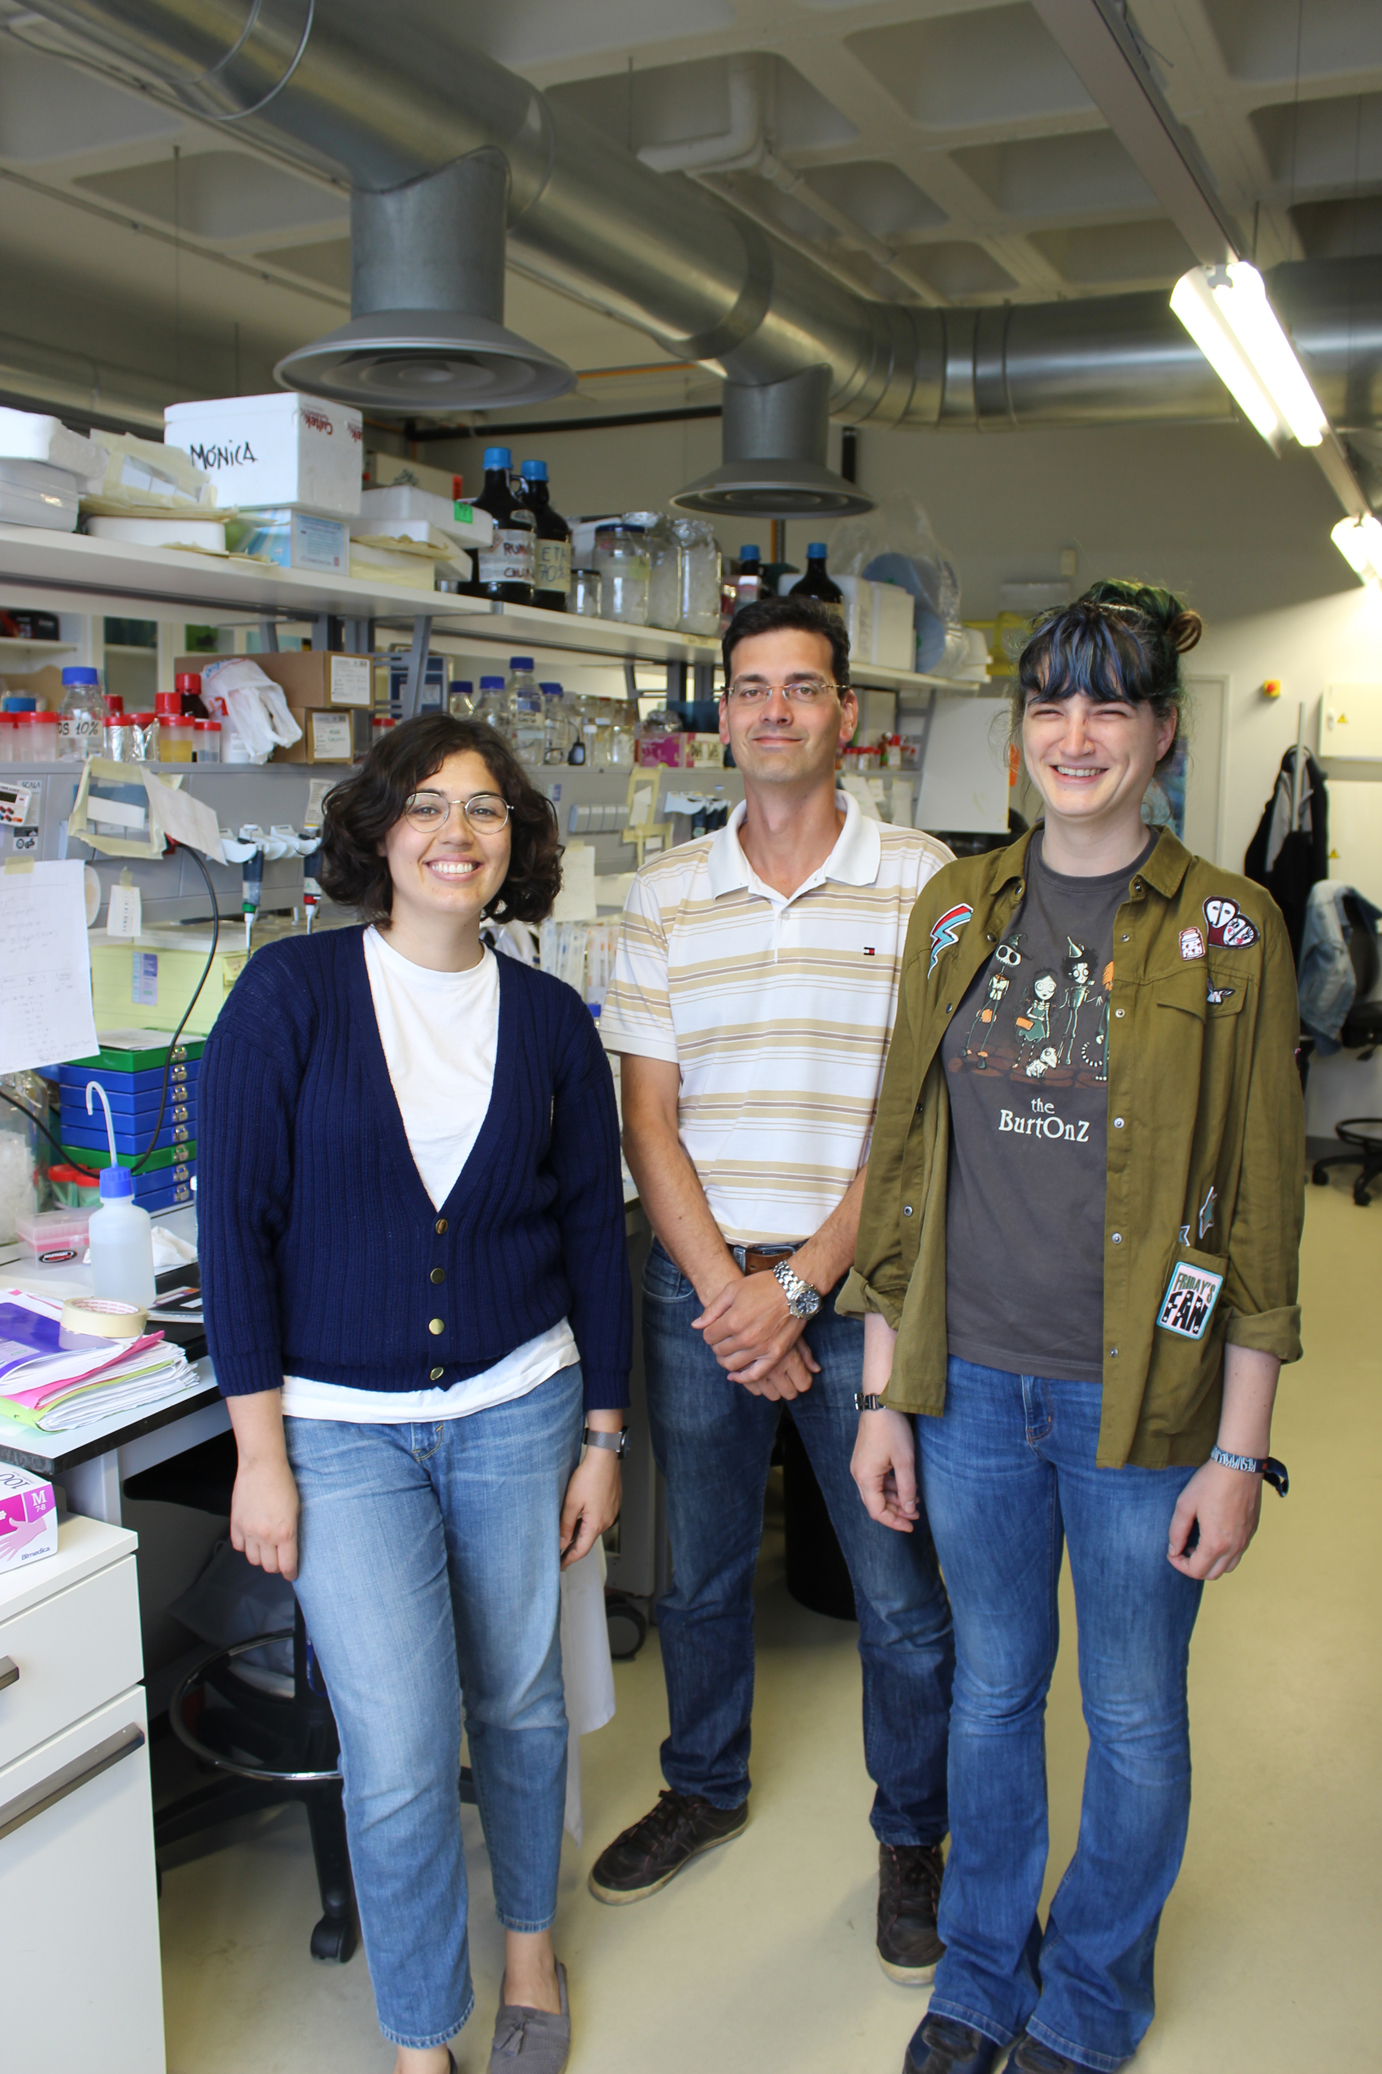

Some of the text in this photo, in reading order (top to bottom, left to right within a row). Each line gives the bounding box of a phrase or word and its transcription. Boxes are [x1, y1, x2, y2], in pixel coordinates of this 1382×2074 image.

[75, 721, 98, 736] 10%
[1030, 1097, 1055, 1114] the
[998, 1109, 1090, 1142] BurtOnZ
[1172, 1272, 1216, 1304] FRIDAY'S
[1161, 1290, 1209, 1335] FAN
[31, 1489, 47, 1507] M
[35, 1503, 46, 1513] 7-8
